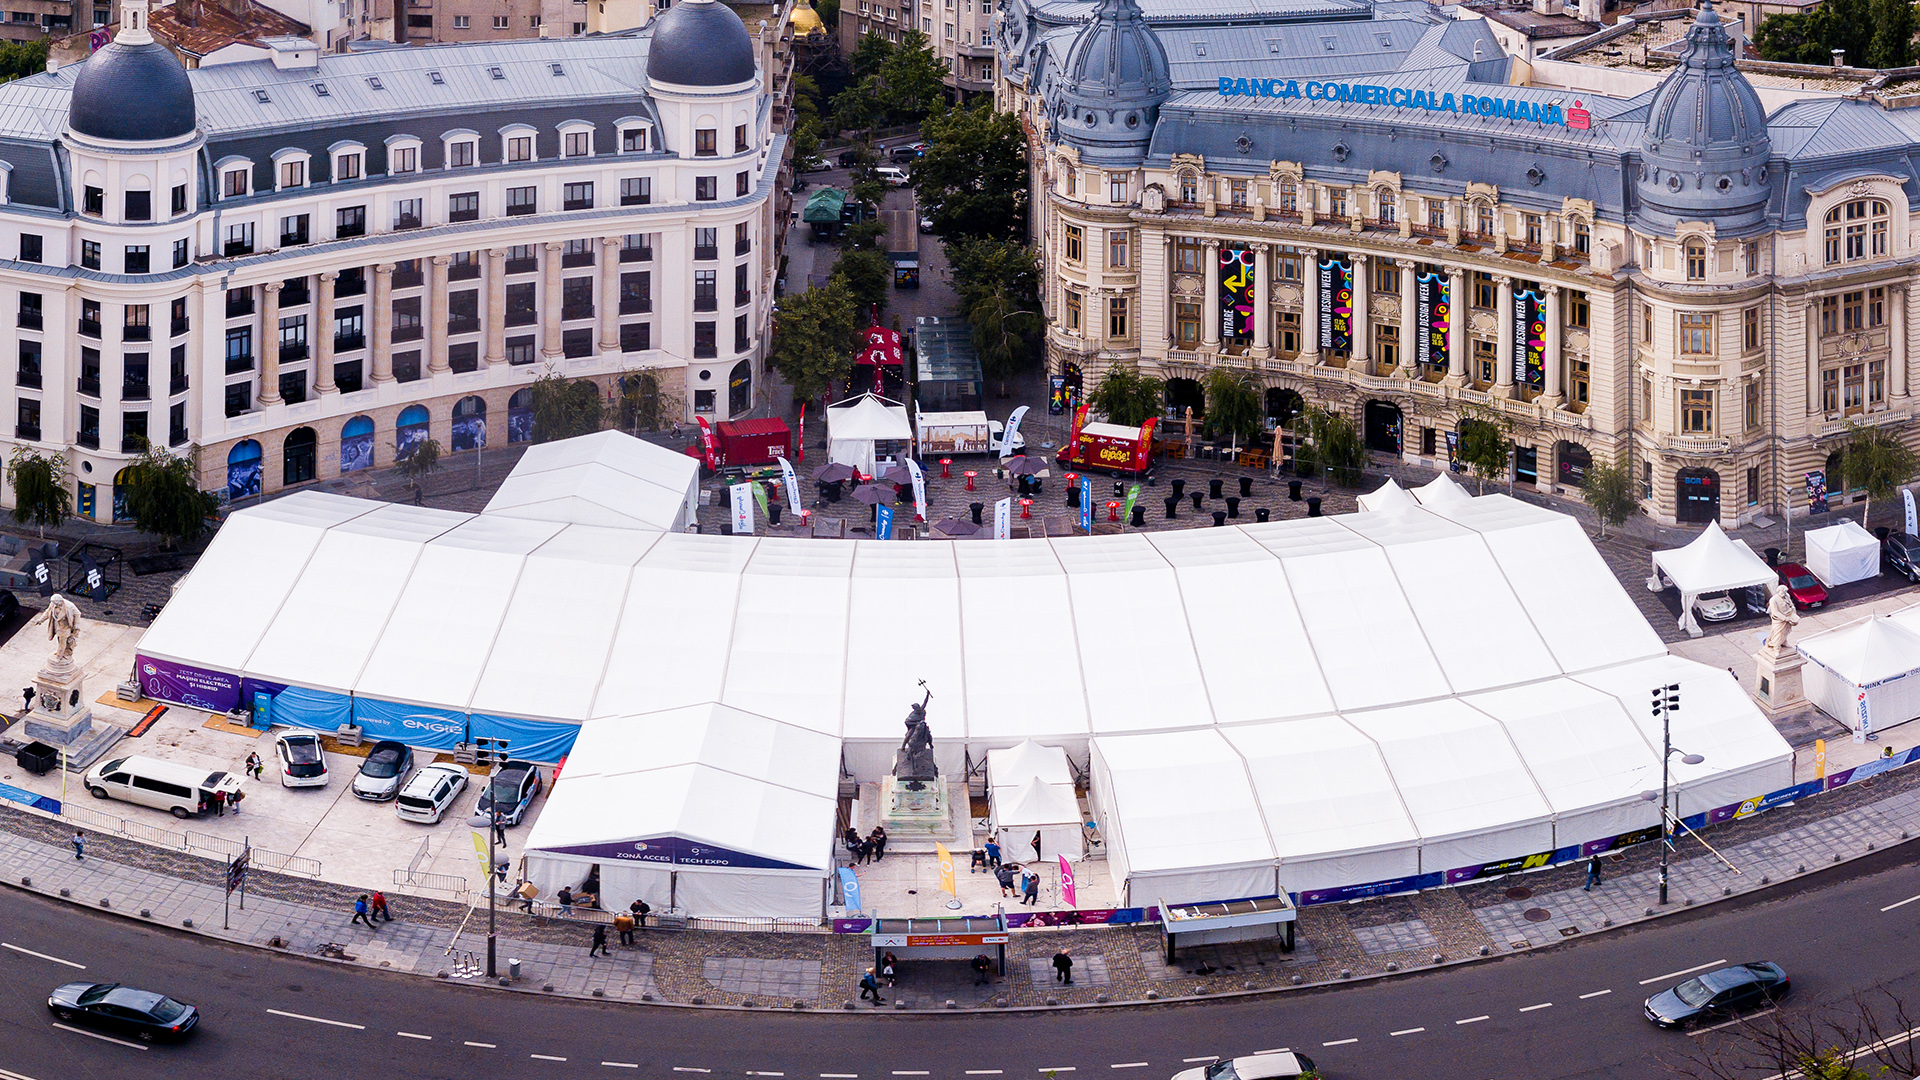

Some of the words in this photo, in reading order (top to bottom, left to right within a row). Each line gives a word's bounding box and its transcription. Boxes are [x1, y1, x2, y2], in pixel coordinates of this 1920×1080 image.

[1218, 76, 1301, 100] BANCA
[1306, 81, 1458, 113] COMERCIALA
[1462, 94, 1565, 127] ROMANA
[1321, 270, 1332, 288] WEEK
[1321, 288, 1332, 313] DESIGN
[1419, 283, 1430, 302] WEEK
[1419, 302, 1430, 327] DESIGN
[1516, 300, 1526, 319] WEEK
[1224, 309, 1234, 337] INTRARE
[1321, 313, 1332, 348] ROMANIAN
[1516, 320, 1526, 345] DESIGN
[1419, 327, 1430, 362] ROMANIAN
[1516, 345, 1526, 381] ROMANIAN
